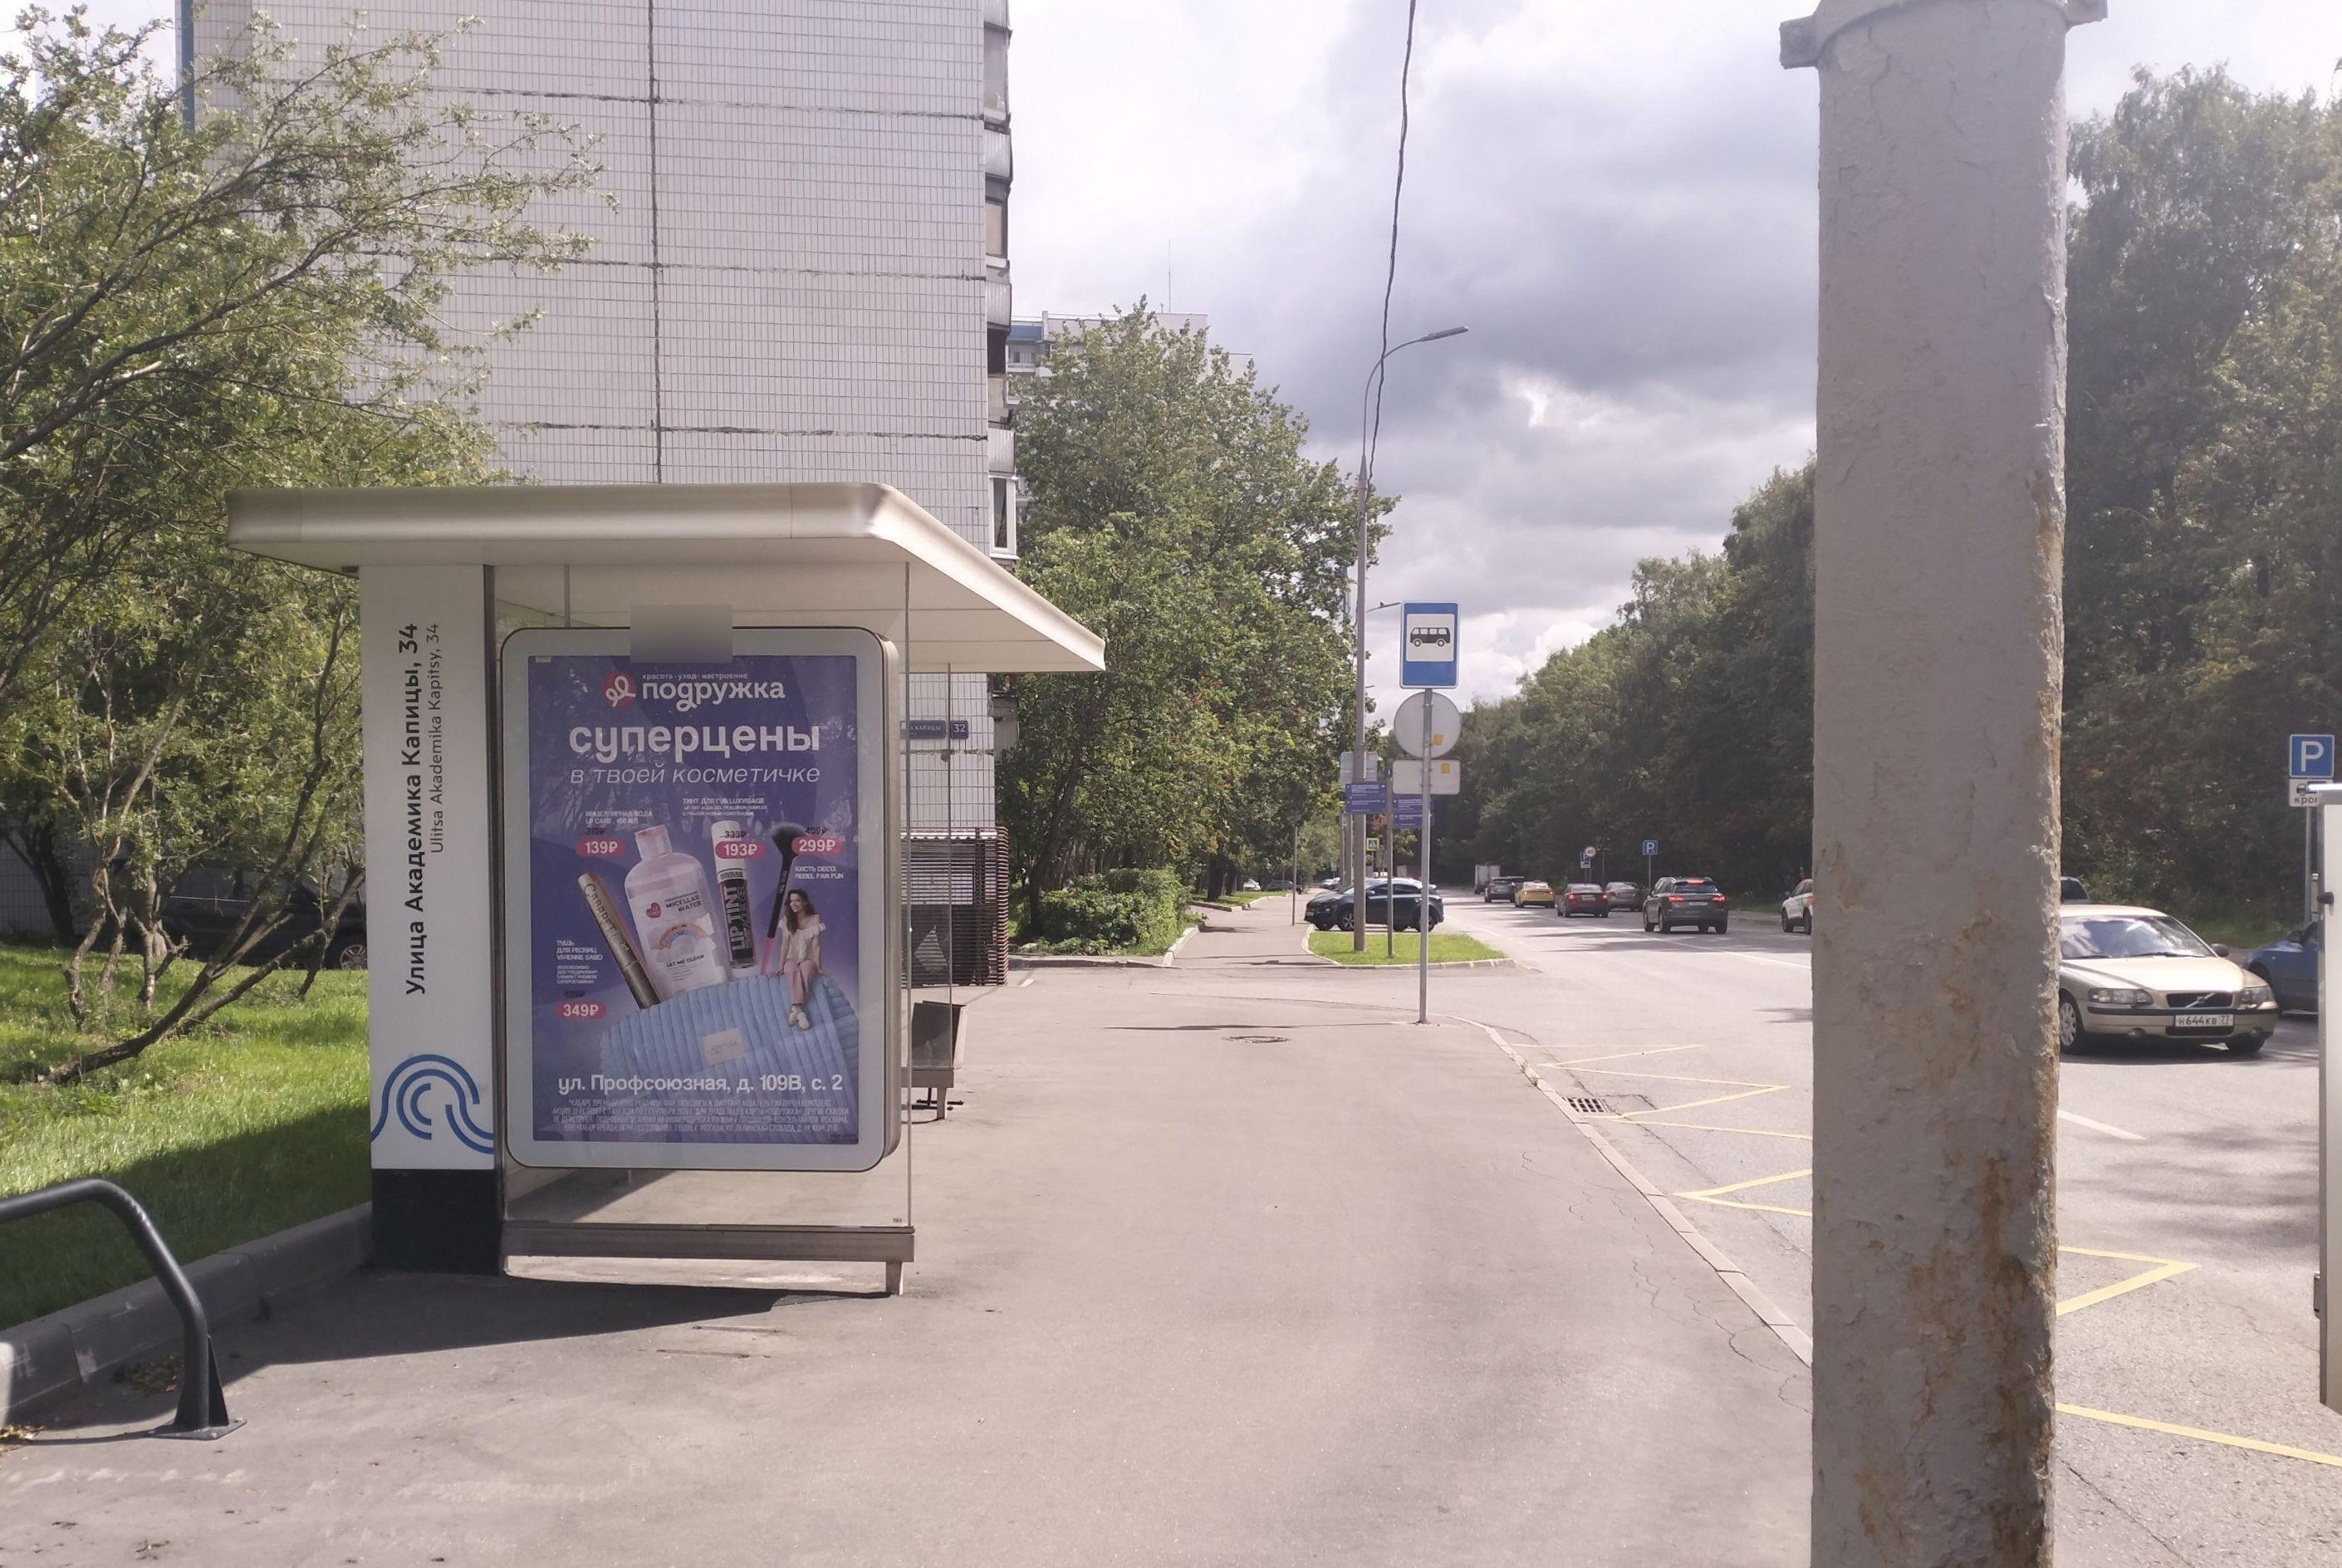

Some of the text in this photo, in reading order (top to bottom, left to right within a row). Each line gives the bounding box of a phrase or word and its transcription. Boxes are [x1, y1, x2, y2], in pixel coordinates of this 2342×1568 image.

[642, 681, 786, 712] подружка
[426, 624, 443, 854] Ulitsa Akademika Kapitsy, 34
[953, 723, 966, 733] 32
[569, 725, 820, 763] суперцены
[2300, 741, 2325, 772] P
[570, 762, 820, 784] в твоей косметичке
[399, 624, 427, 995] Улица Академика Капицы, 34
[558, 1074, 843, 1095] ул. Профсоюзная, д. 109В, с. 2
